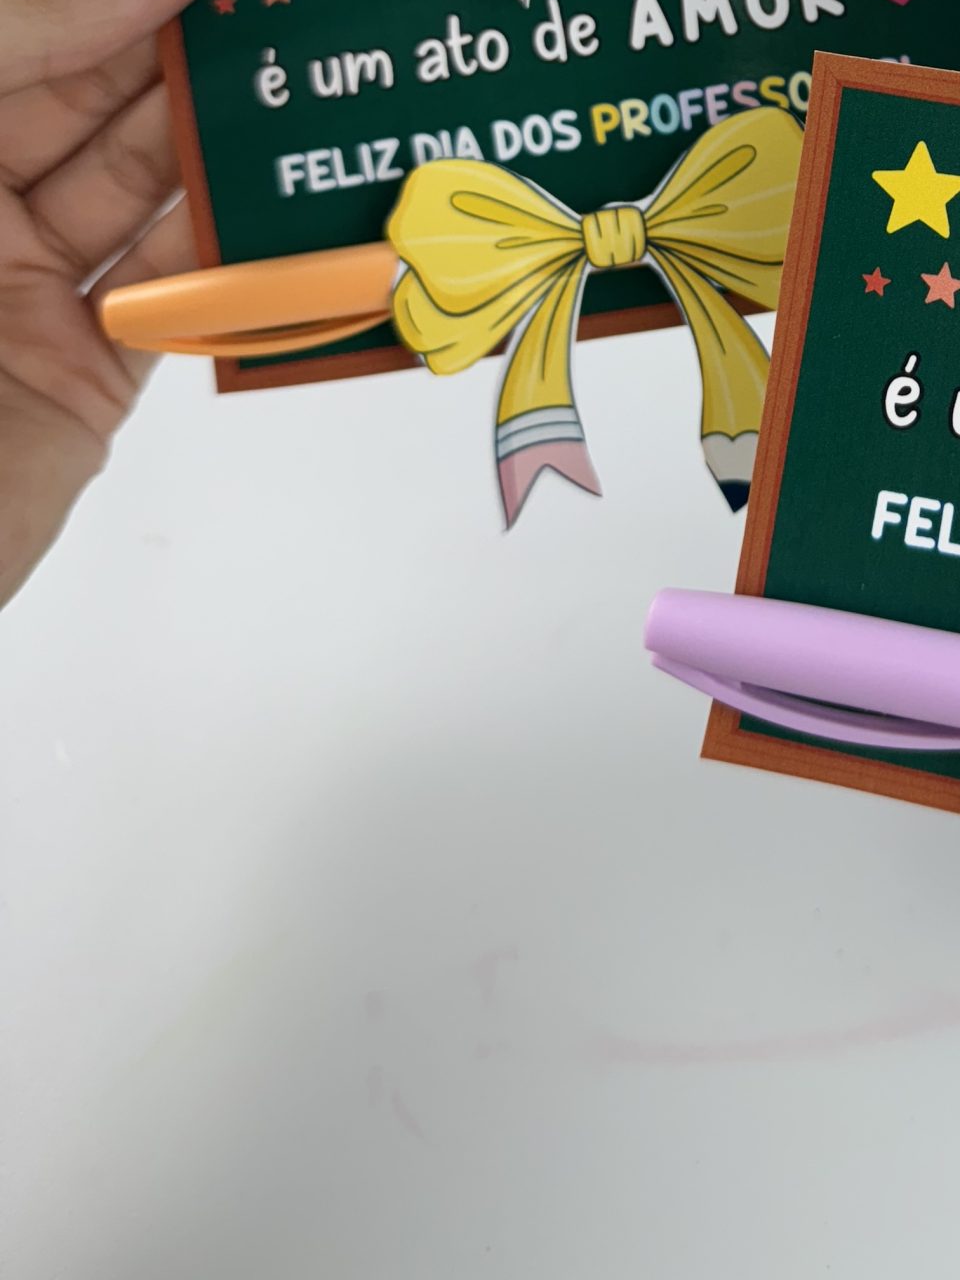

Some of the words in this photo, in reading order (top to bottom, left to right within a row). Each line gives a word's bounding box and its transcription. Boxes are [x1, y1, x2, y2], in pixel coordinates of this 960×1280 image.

[257, 47, 290, 108] é
[311, 46, 395, 99] um
[416, 13, 510, 83] ato
[277, 138, 405, 197] FELIZ
[412, 125, 483, 164] DIA
[492, 110, 581, 160] DOS
[883, 354, 922, 428] é
